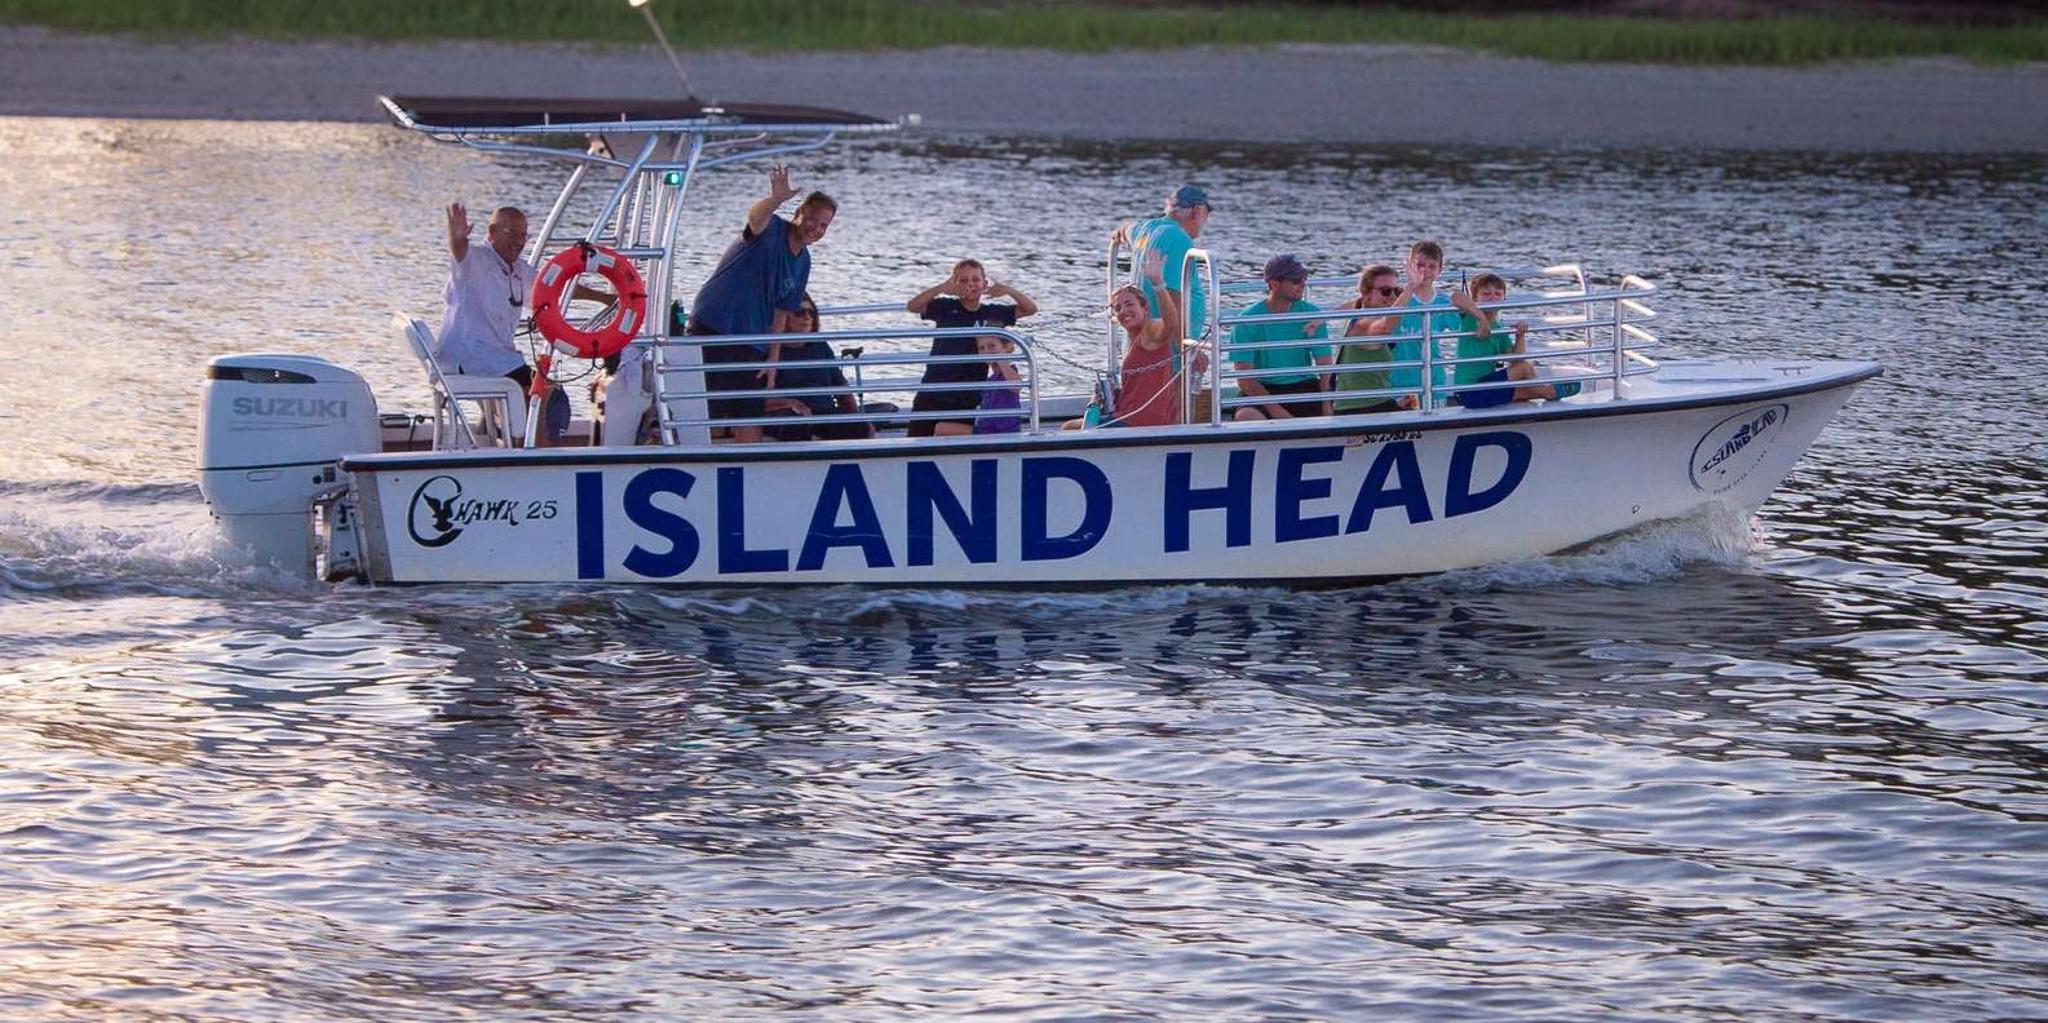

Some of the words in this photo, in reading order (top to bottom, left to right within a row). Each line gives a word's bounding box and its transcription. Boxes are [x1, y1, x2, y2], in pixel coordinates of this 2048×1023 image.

[232, 397, 348, 418] SUZUKI
[526, 500, 558, 520] 25
[575, 456, 1113, 580] ISLAND
[1164, 431, 1533, 553] HEAD
